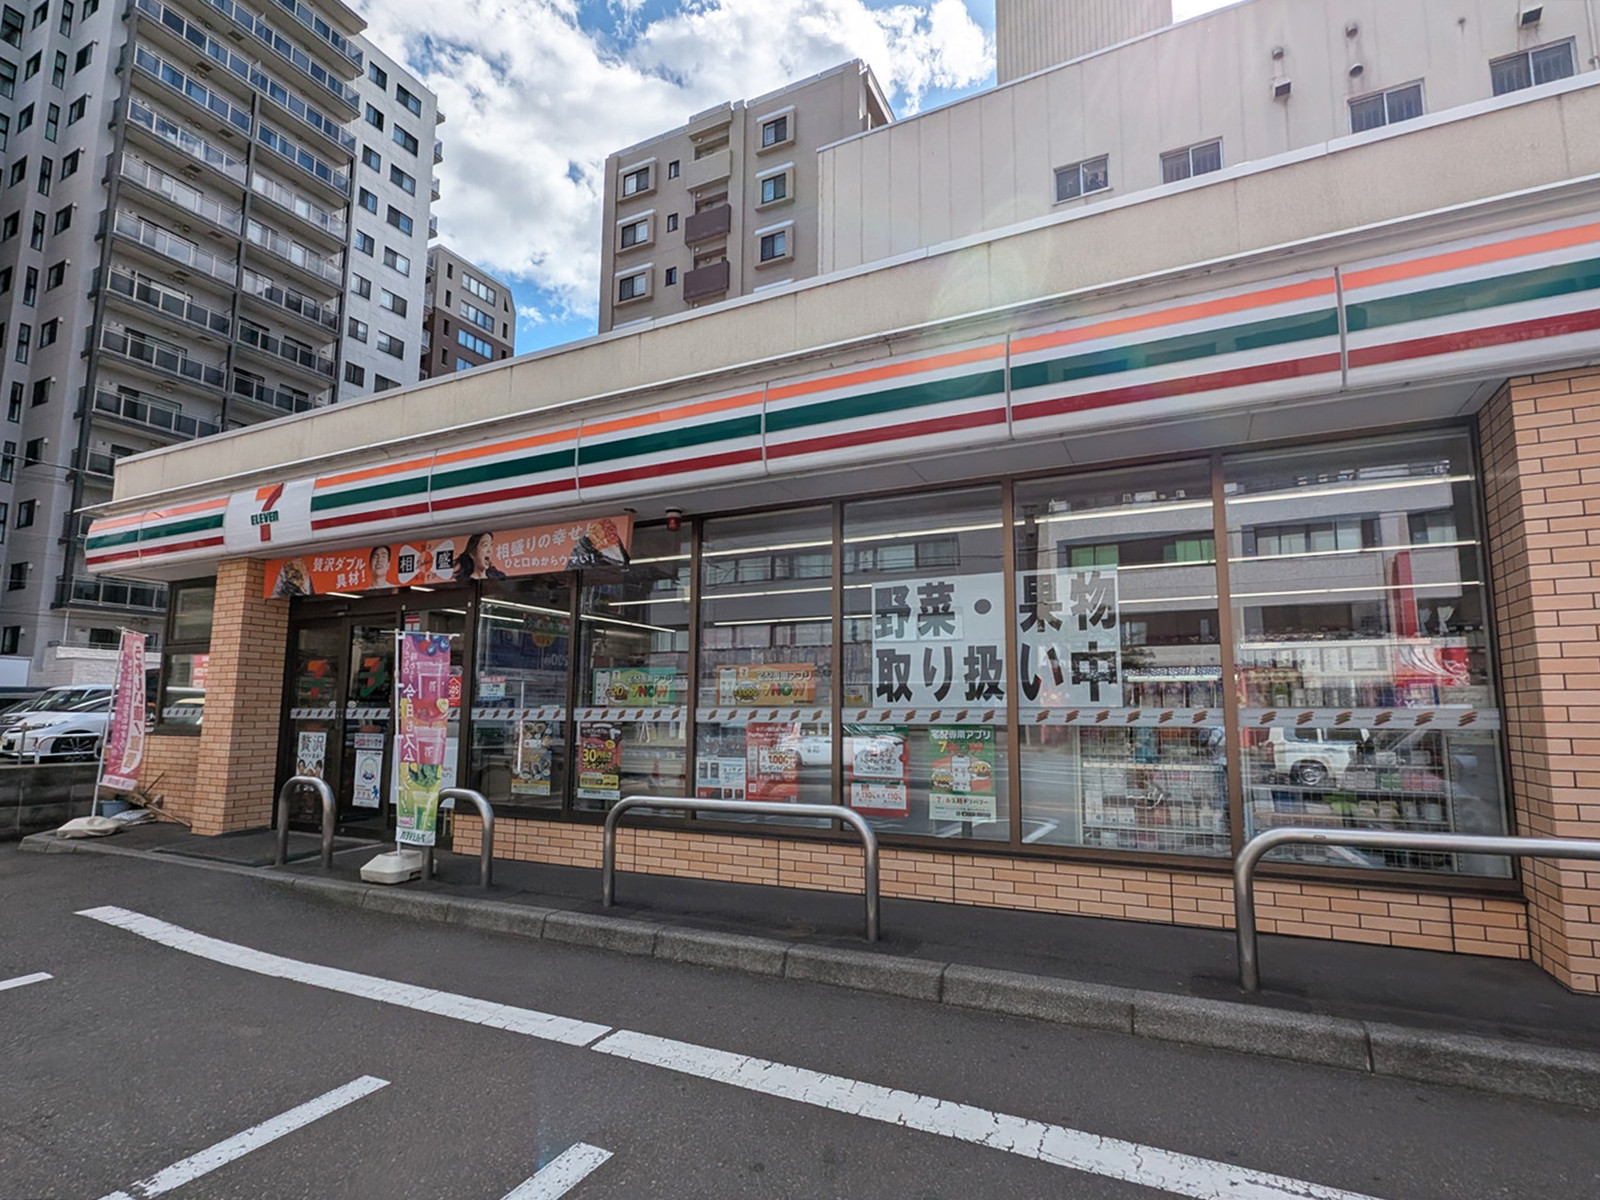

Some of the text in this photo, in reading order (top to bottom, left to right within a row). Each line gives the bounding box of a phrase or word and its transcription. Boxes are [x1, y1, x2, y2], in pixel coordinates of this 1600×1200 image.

[312, 556, 366, 573] 贅沢ダブル
[875, 570, 1117, 640] 野菜・果物
[876, 641, 1118, 703] 取り扱い中
